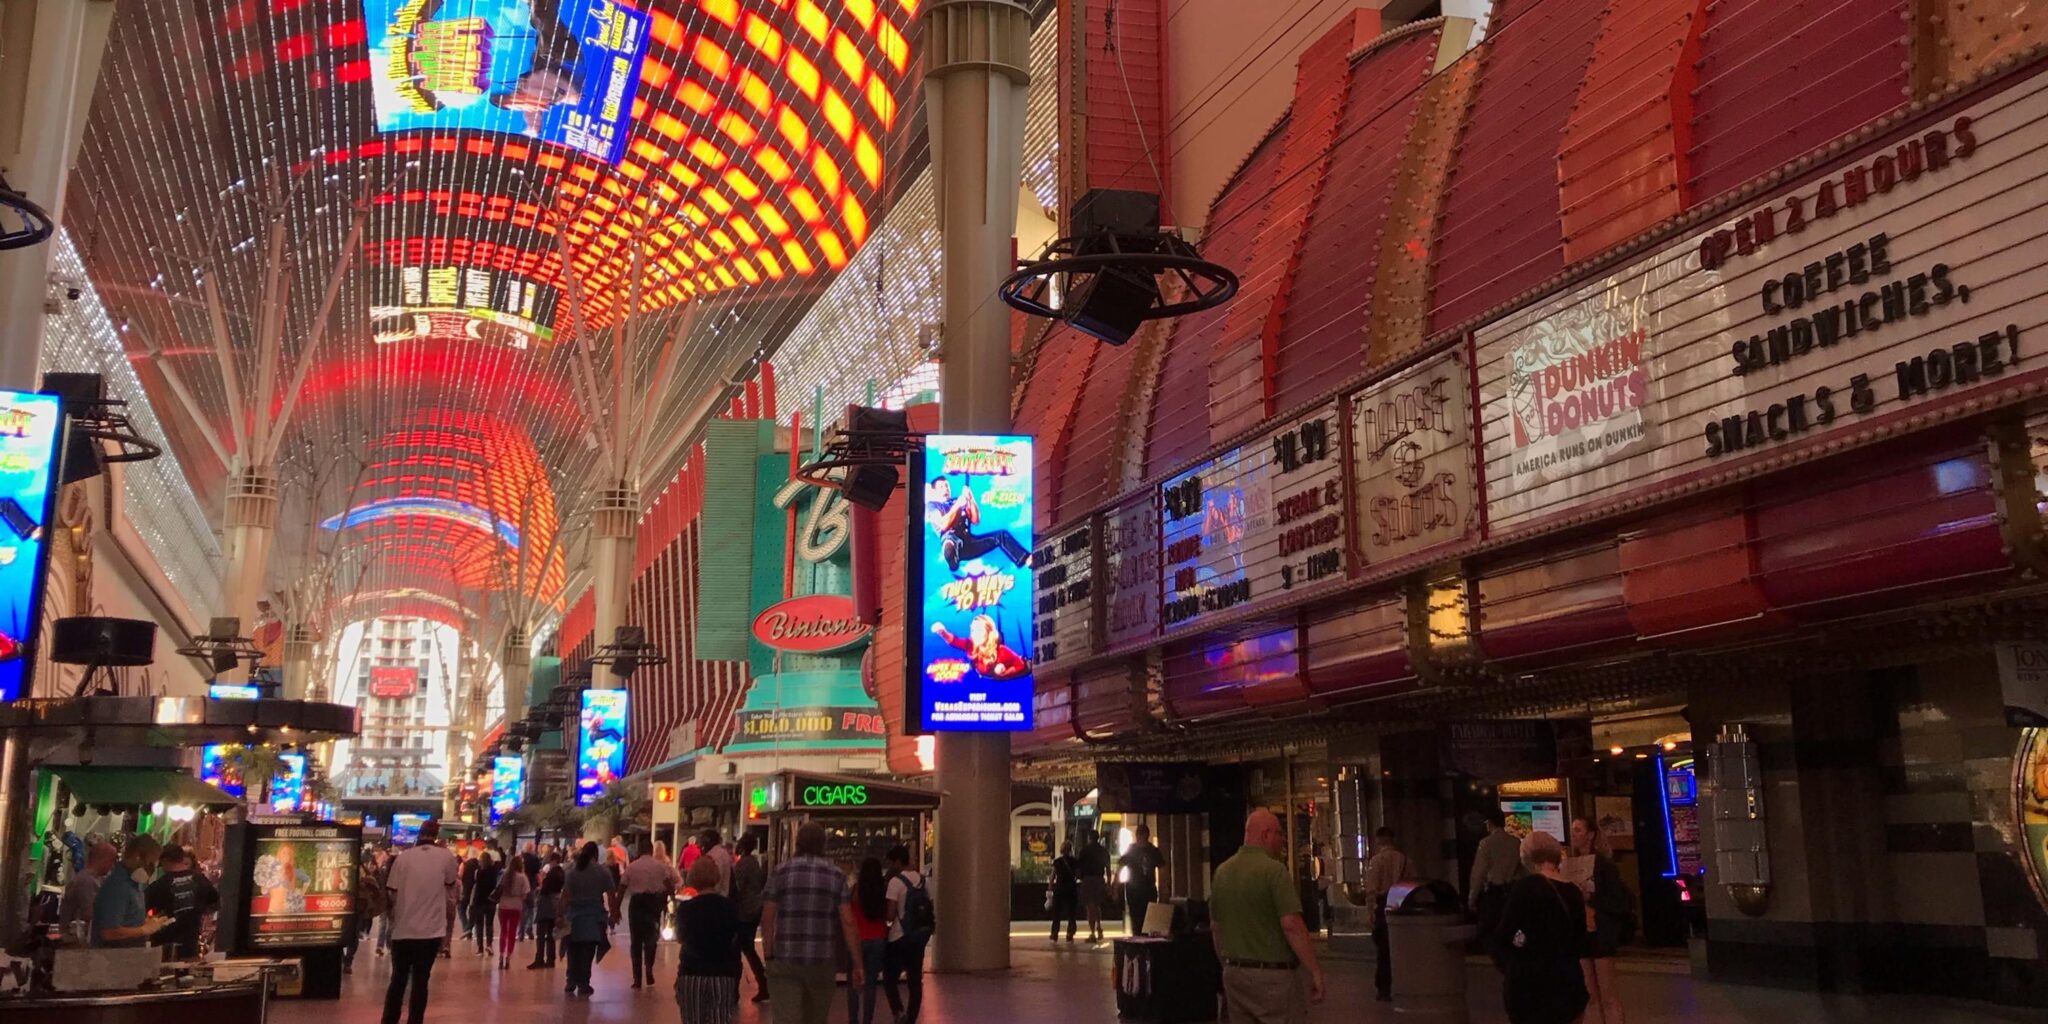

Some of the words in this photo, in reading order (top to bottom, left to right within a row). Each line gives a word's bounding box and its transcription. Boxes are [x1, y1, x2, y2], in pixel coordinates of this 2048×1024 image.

[1700, 206, 1775, 271] OPEN
[1844, 116, 1977, 208] HOURS
[1762, 232, 1891, 315] COFFEE
[1731, 263, 1970, 376] SANDWICHES,
[1545, 328, 1646, 400] DUNKIN'
[1704, 386, 1836, 458] SNACKS
[1895, 324, 2023, 401] MORE!
[1547, 370, 1648, 436] DONUTS
[1516, 454, 1558, 477] AMERICA
[1559, 442, 1586, 462] RUNS
[1587, 435, 1603, 452] ON
[941, 577, 973, 600] TWO
[976, 573, 1015, 593] WAYS
[955, 591, 975, 611] TO
[977, 588, 1004, 608] FLY
[803, 784, 867, 807] CIGARS
[274, 828, 289, 838] FREE
[288, 828, 314, 838] FOOTBALL
[314, 828, 338, 838] CONTEST
